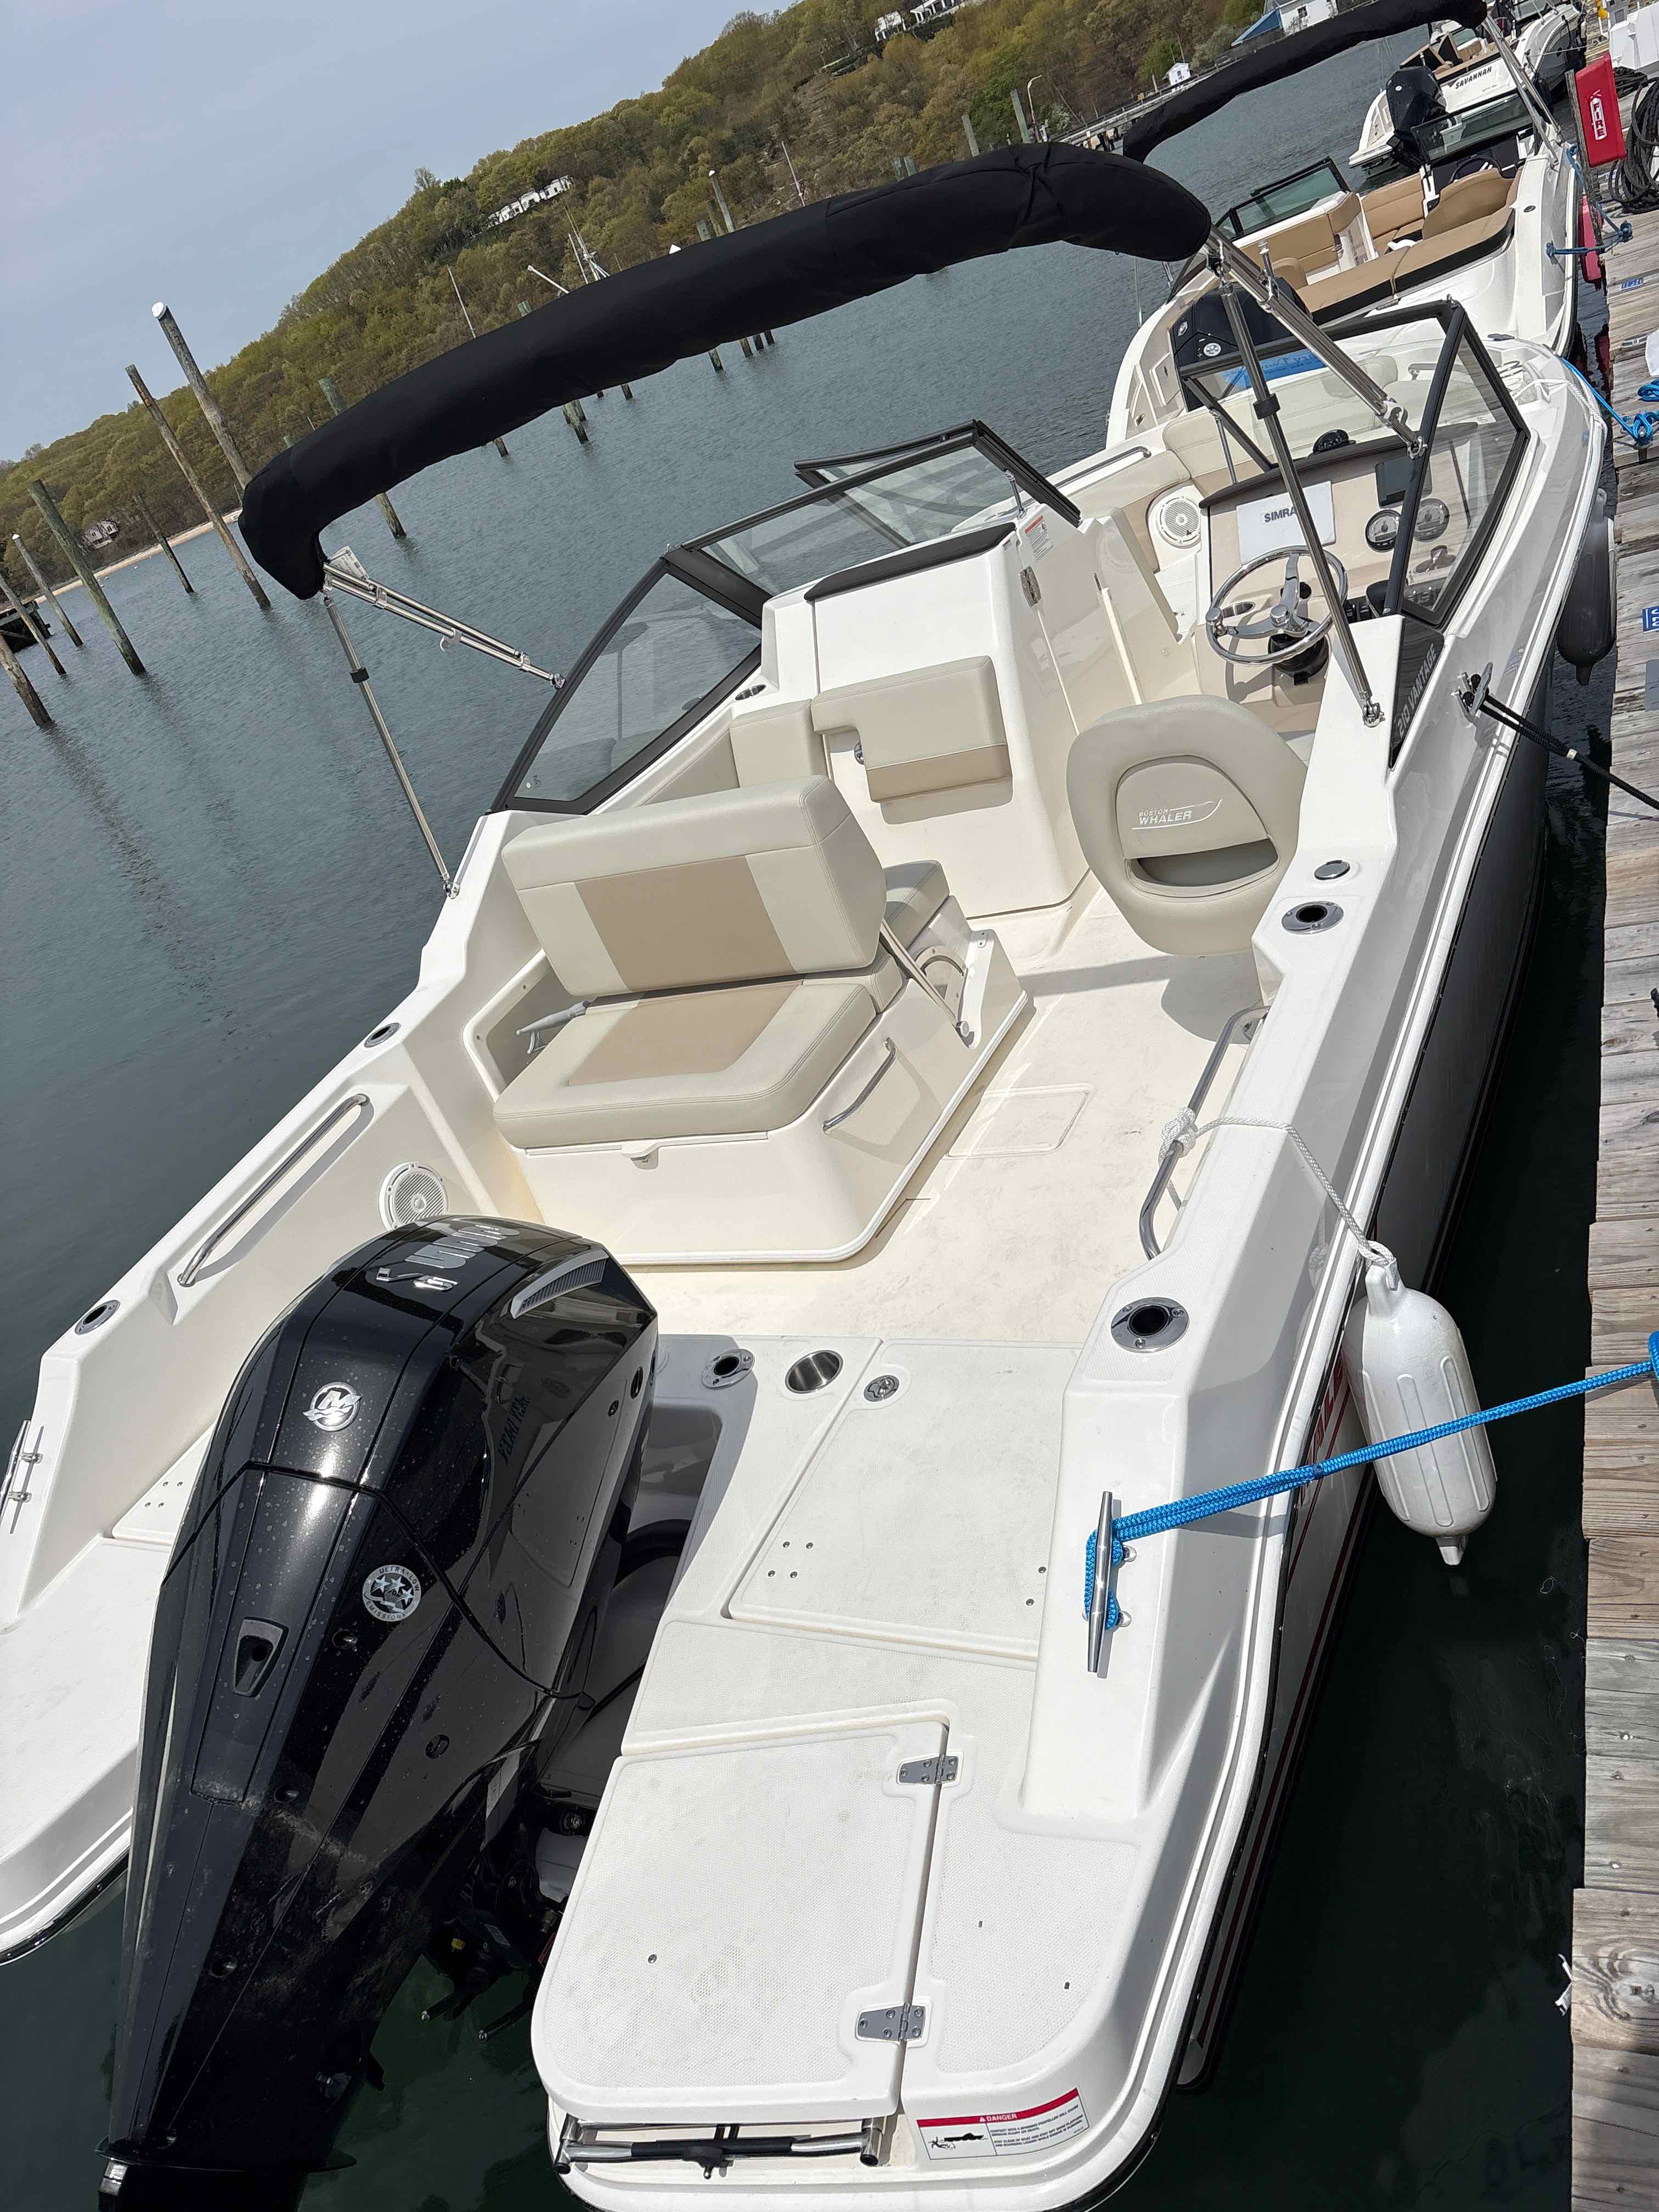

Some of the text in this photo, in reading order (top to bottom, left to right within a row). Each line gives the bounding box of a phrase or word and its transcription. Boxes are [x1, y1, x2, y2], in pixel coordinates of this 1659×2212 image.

[1455, 66, 1492, 89] SAVANNAH
[1593, 102, 1605, 137] FIRE
[1264, 506, 1296, 523] SIMRA
[1398, 643, 1437, 738] 210 VANTAGE
[1139, 810, 1193, 826] WHALER
[987, 2113, 1018, 2122] DANGER
